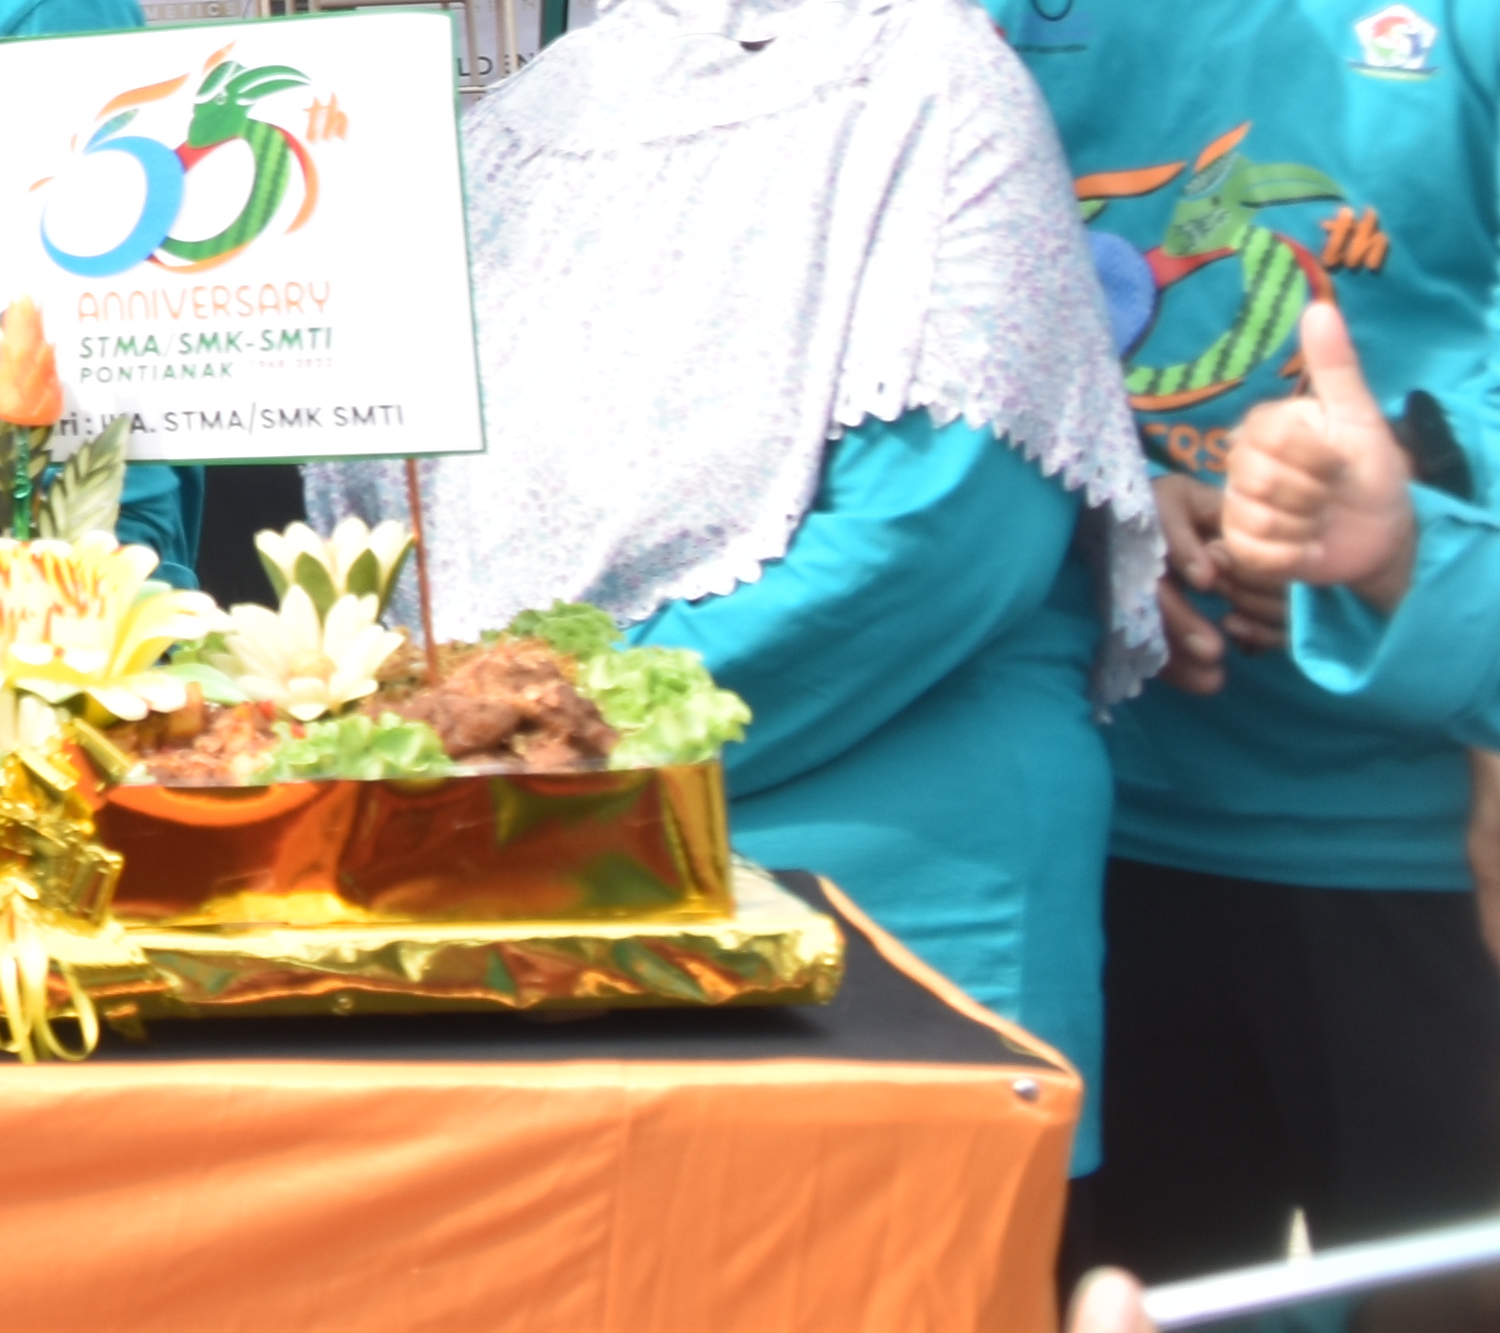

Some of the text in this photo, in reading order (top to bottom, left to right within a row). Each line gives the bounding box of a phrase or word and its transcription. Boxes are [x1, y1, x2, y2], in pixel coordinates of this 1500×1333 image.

[77, 280, 331, 323] ANNIVERSARY
[78, 326, 333, 359] STMA/SMK-SMTI
[79, 362, 235, 384] PONTIANAK
[163, 401, 324, 434] STMA/SMK
[332, 404, 404, 427] SMTI
